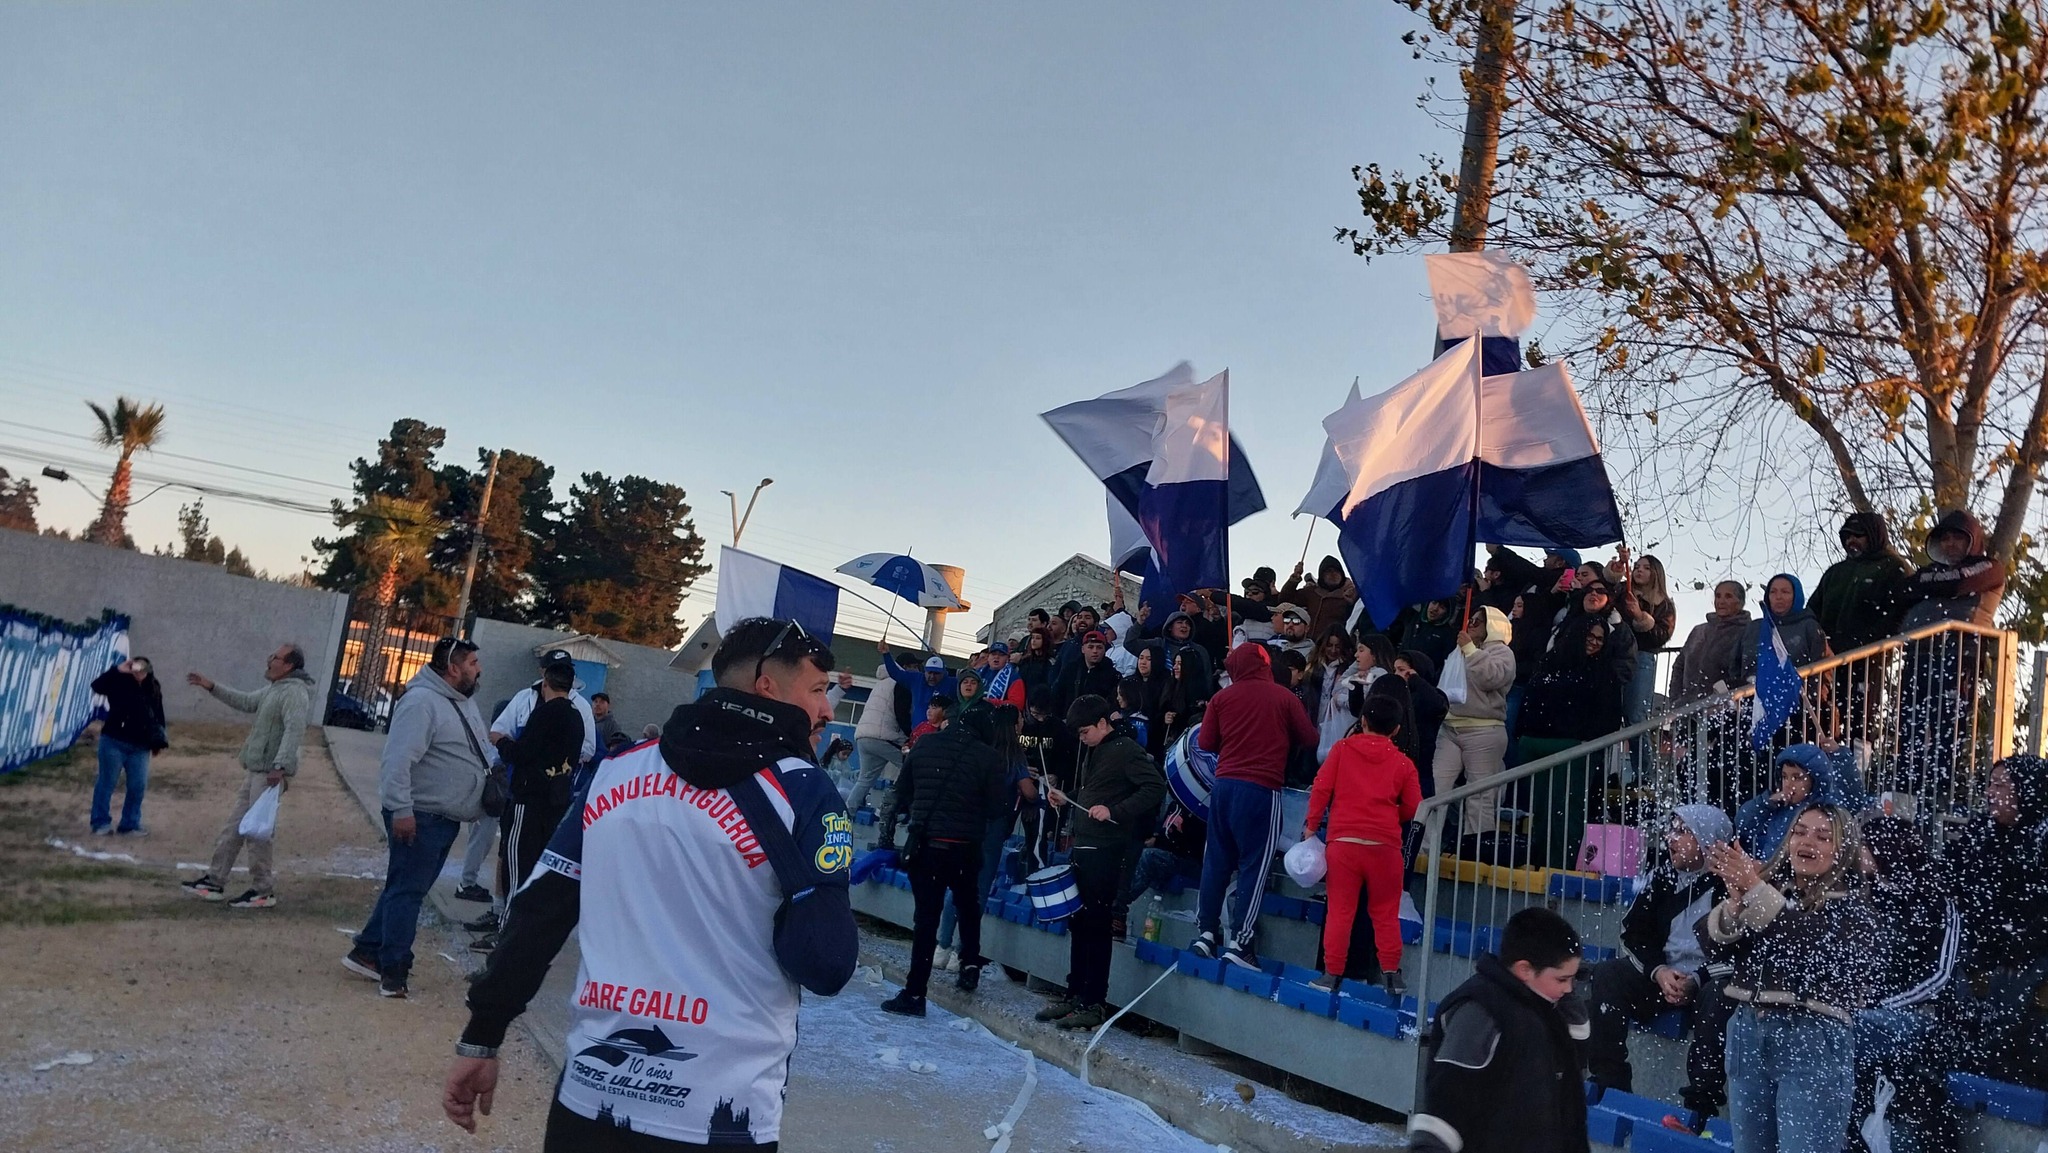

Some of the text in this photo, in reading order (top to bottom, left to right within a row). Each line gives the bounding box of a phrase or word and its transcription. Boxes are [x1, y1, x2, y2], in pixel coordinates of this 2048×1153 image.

[582, 772, 769, 870] MANUELA FIGUEROA
[579, 980, 709, 1025] CARE GALLO
[628, 1057, 674, 1081] 10 años
[649, 1095, 686, 1108] SERVICIO
